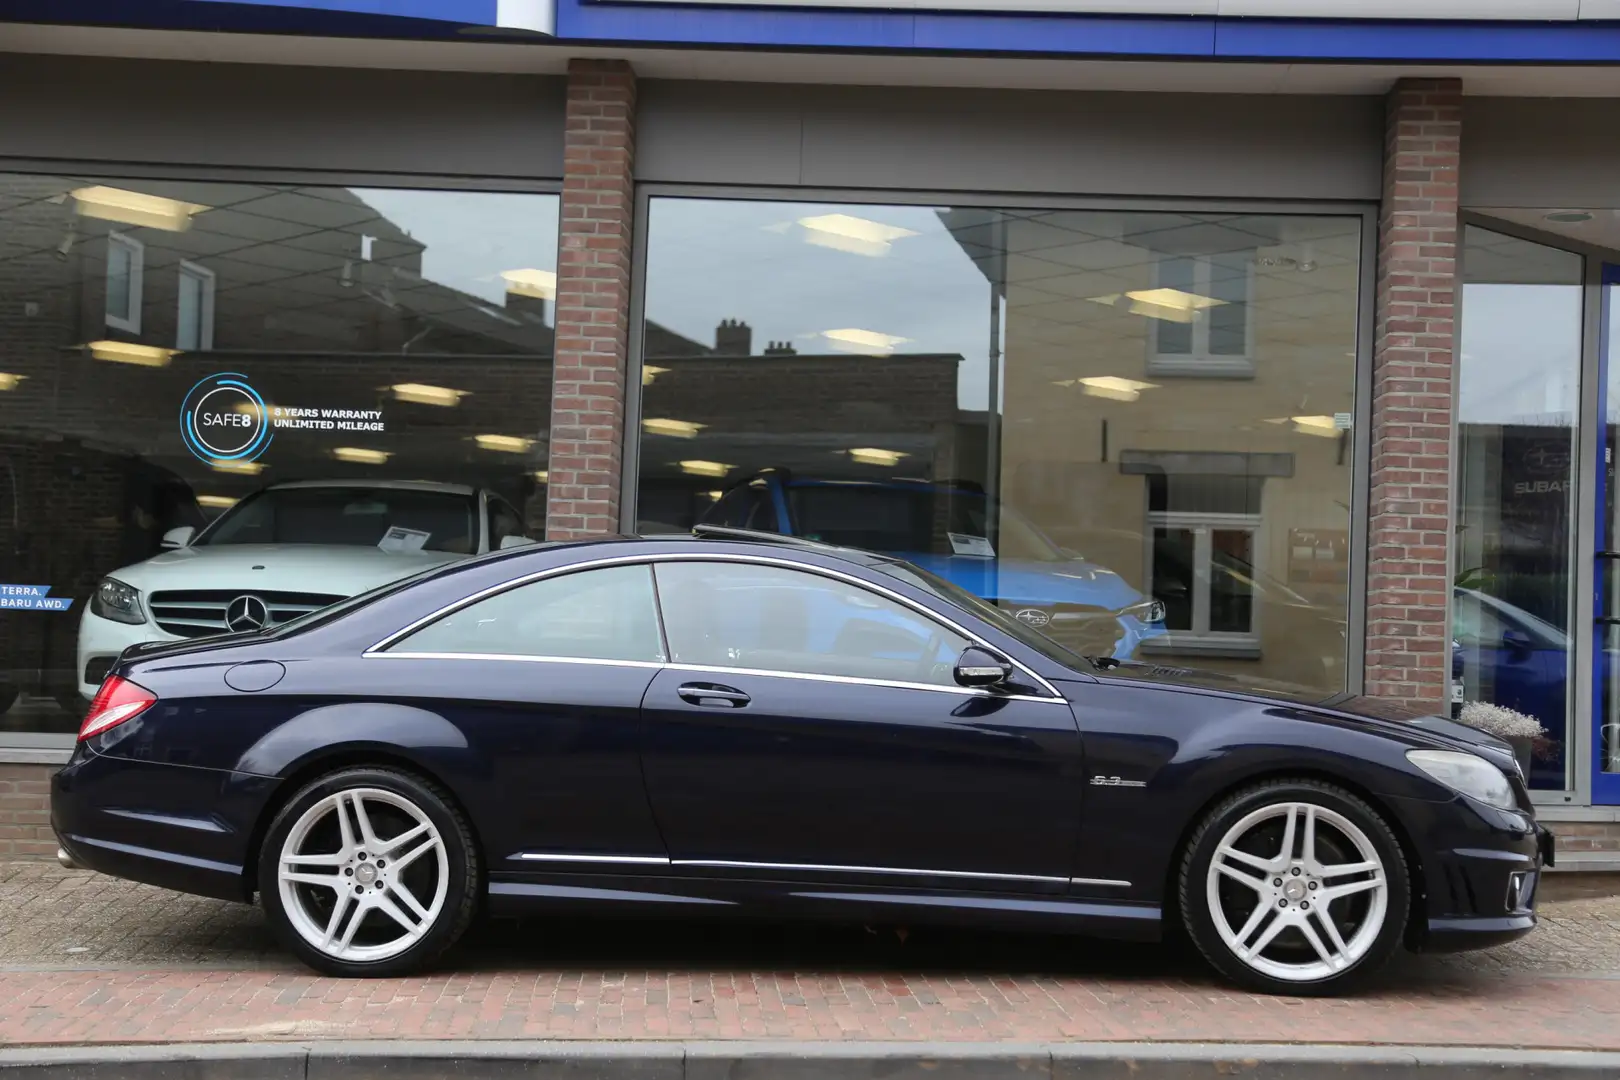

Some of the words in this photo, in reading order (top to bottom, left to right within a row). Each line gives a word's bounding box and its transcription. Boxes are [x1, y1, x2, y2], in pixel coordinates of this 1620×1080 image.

[274, 407, 281, 416] 8
[284, 408, 319, 418] YEARS
[321, 409, 382, 420] WARRANTY
[203, 412, 252, 428] SAFE8
[274, 419, 335, 430] UNLIMITED
[337, 421, 385, 431] MILEAGE
[1, 586, 42, 596] TERRA.
[1, 598, 32, 608] BARU
[36, 599, 65, 609] AWD.
